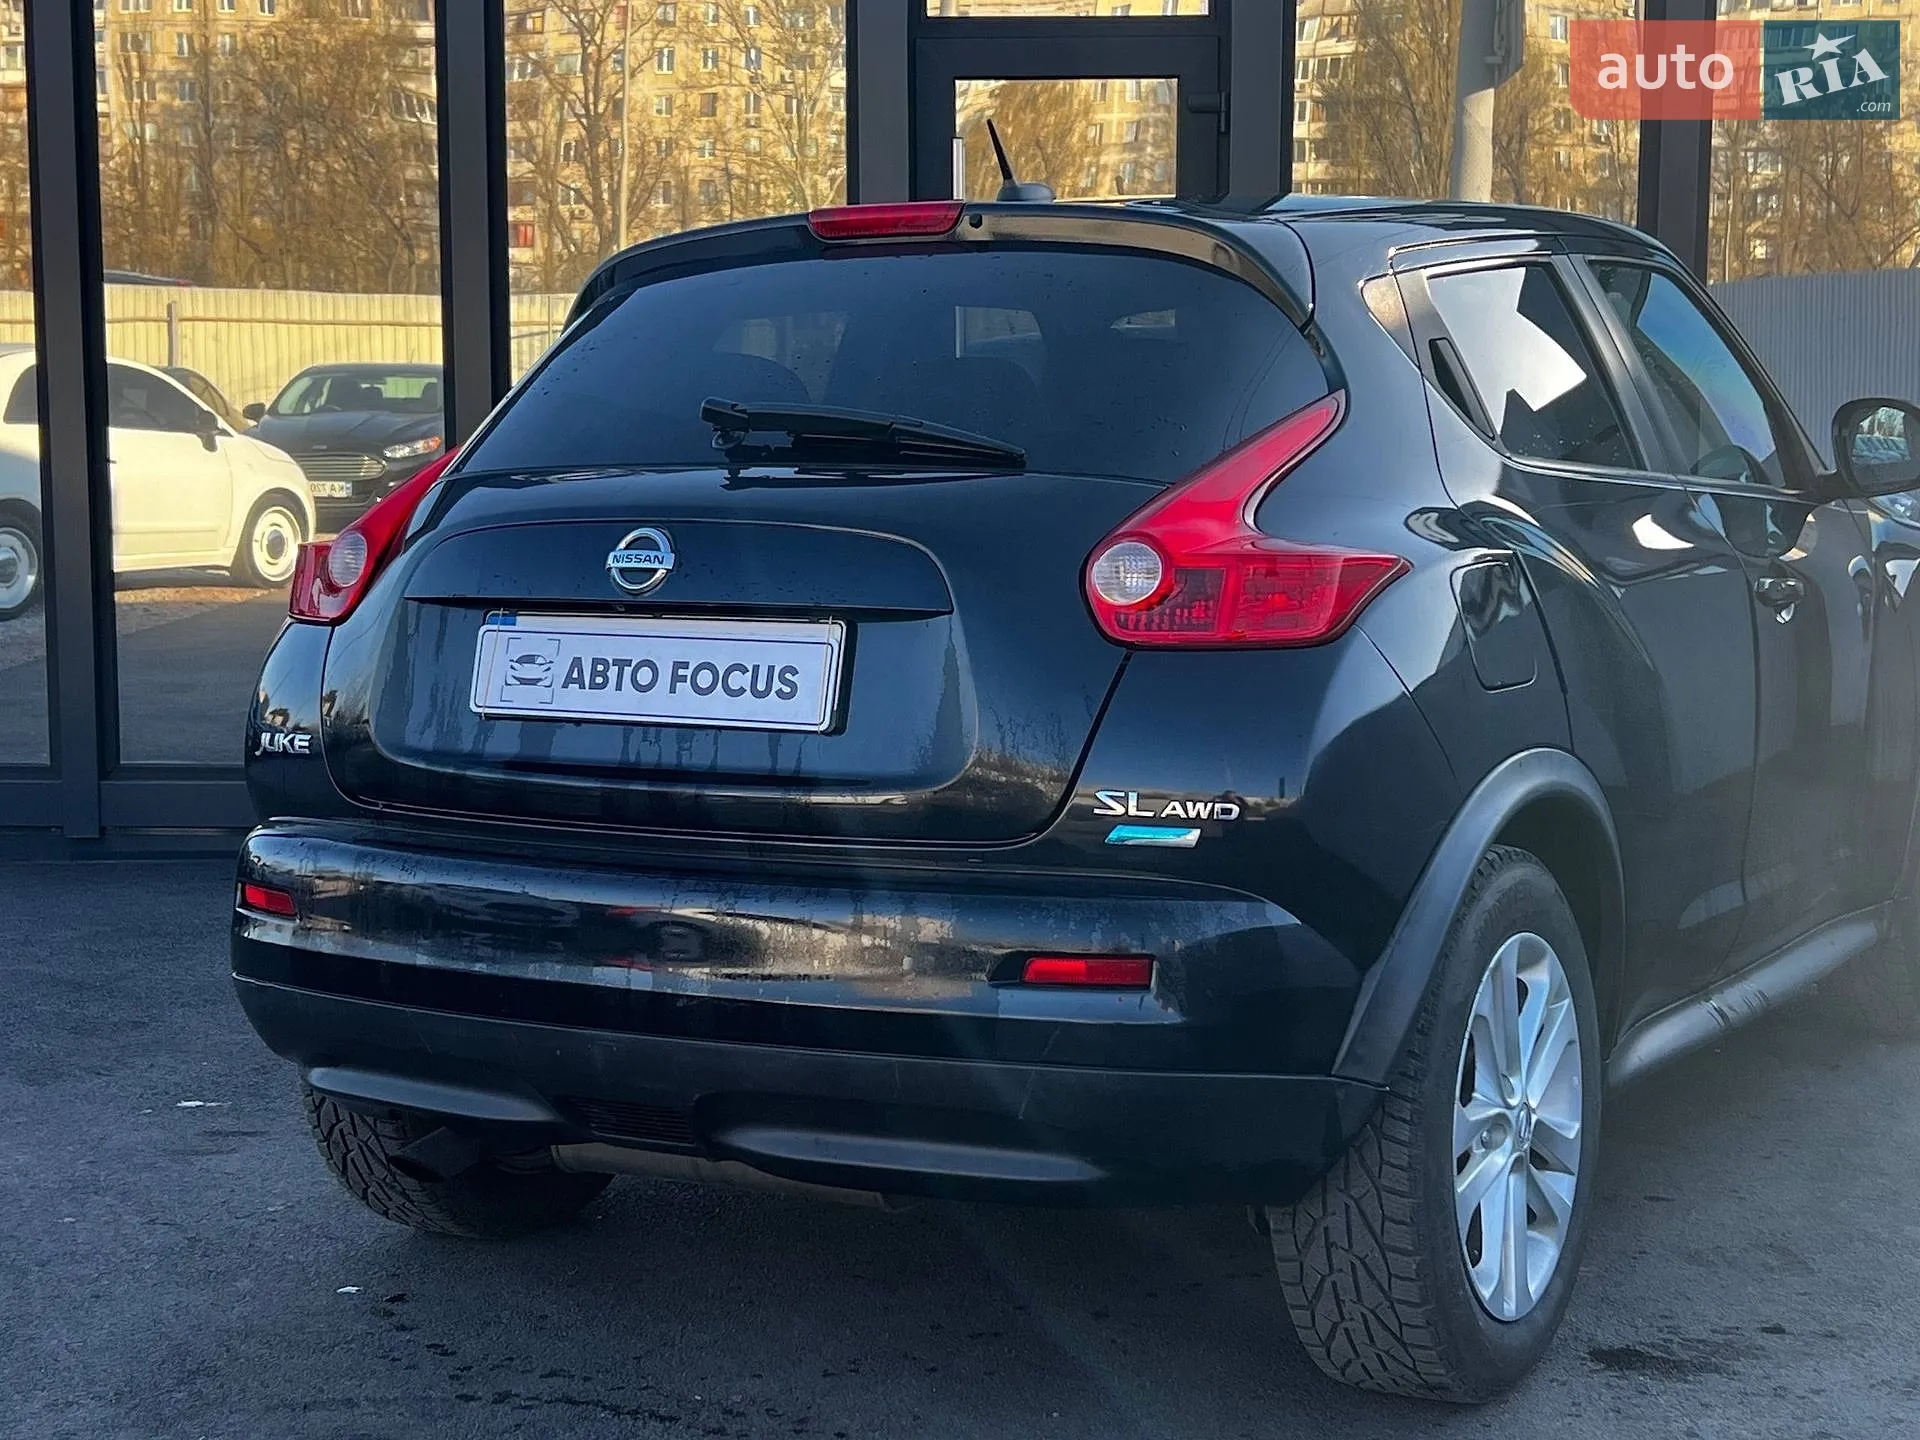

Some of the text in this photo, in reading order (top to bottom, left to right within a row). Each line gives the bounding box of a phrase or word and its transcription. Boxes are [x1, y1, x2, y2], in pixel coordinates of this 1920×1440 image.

[612, 553, 665, 565] NISSAN
[561, 656, 800, 701] АВТО FOCUS
[254, 732, 312, 756] JUKE
[1093, 790, 1240, 821] SL AWD
